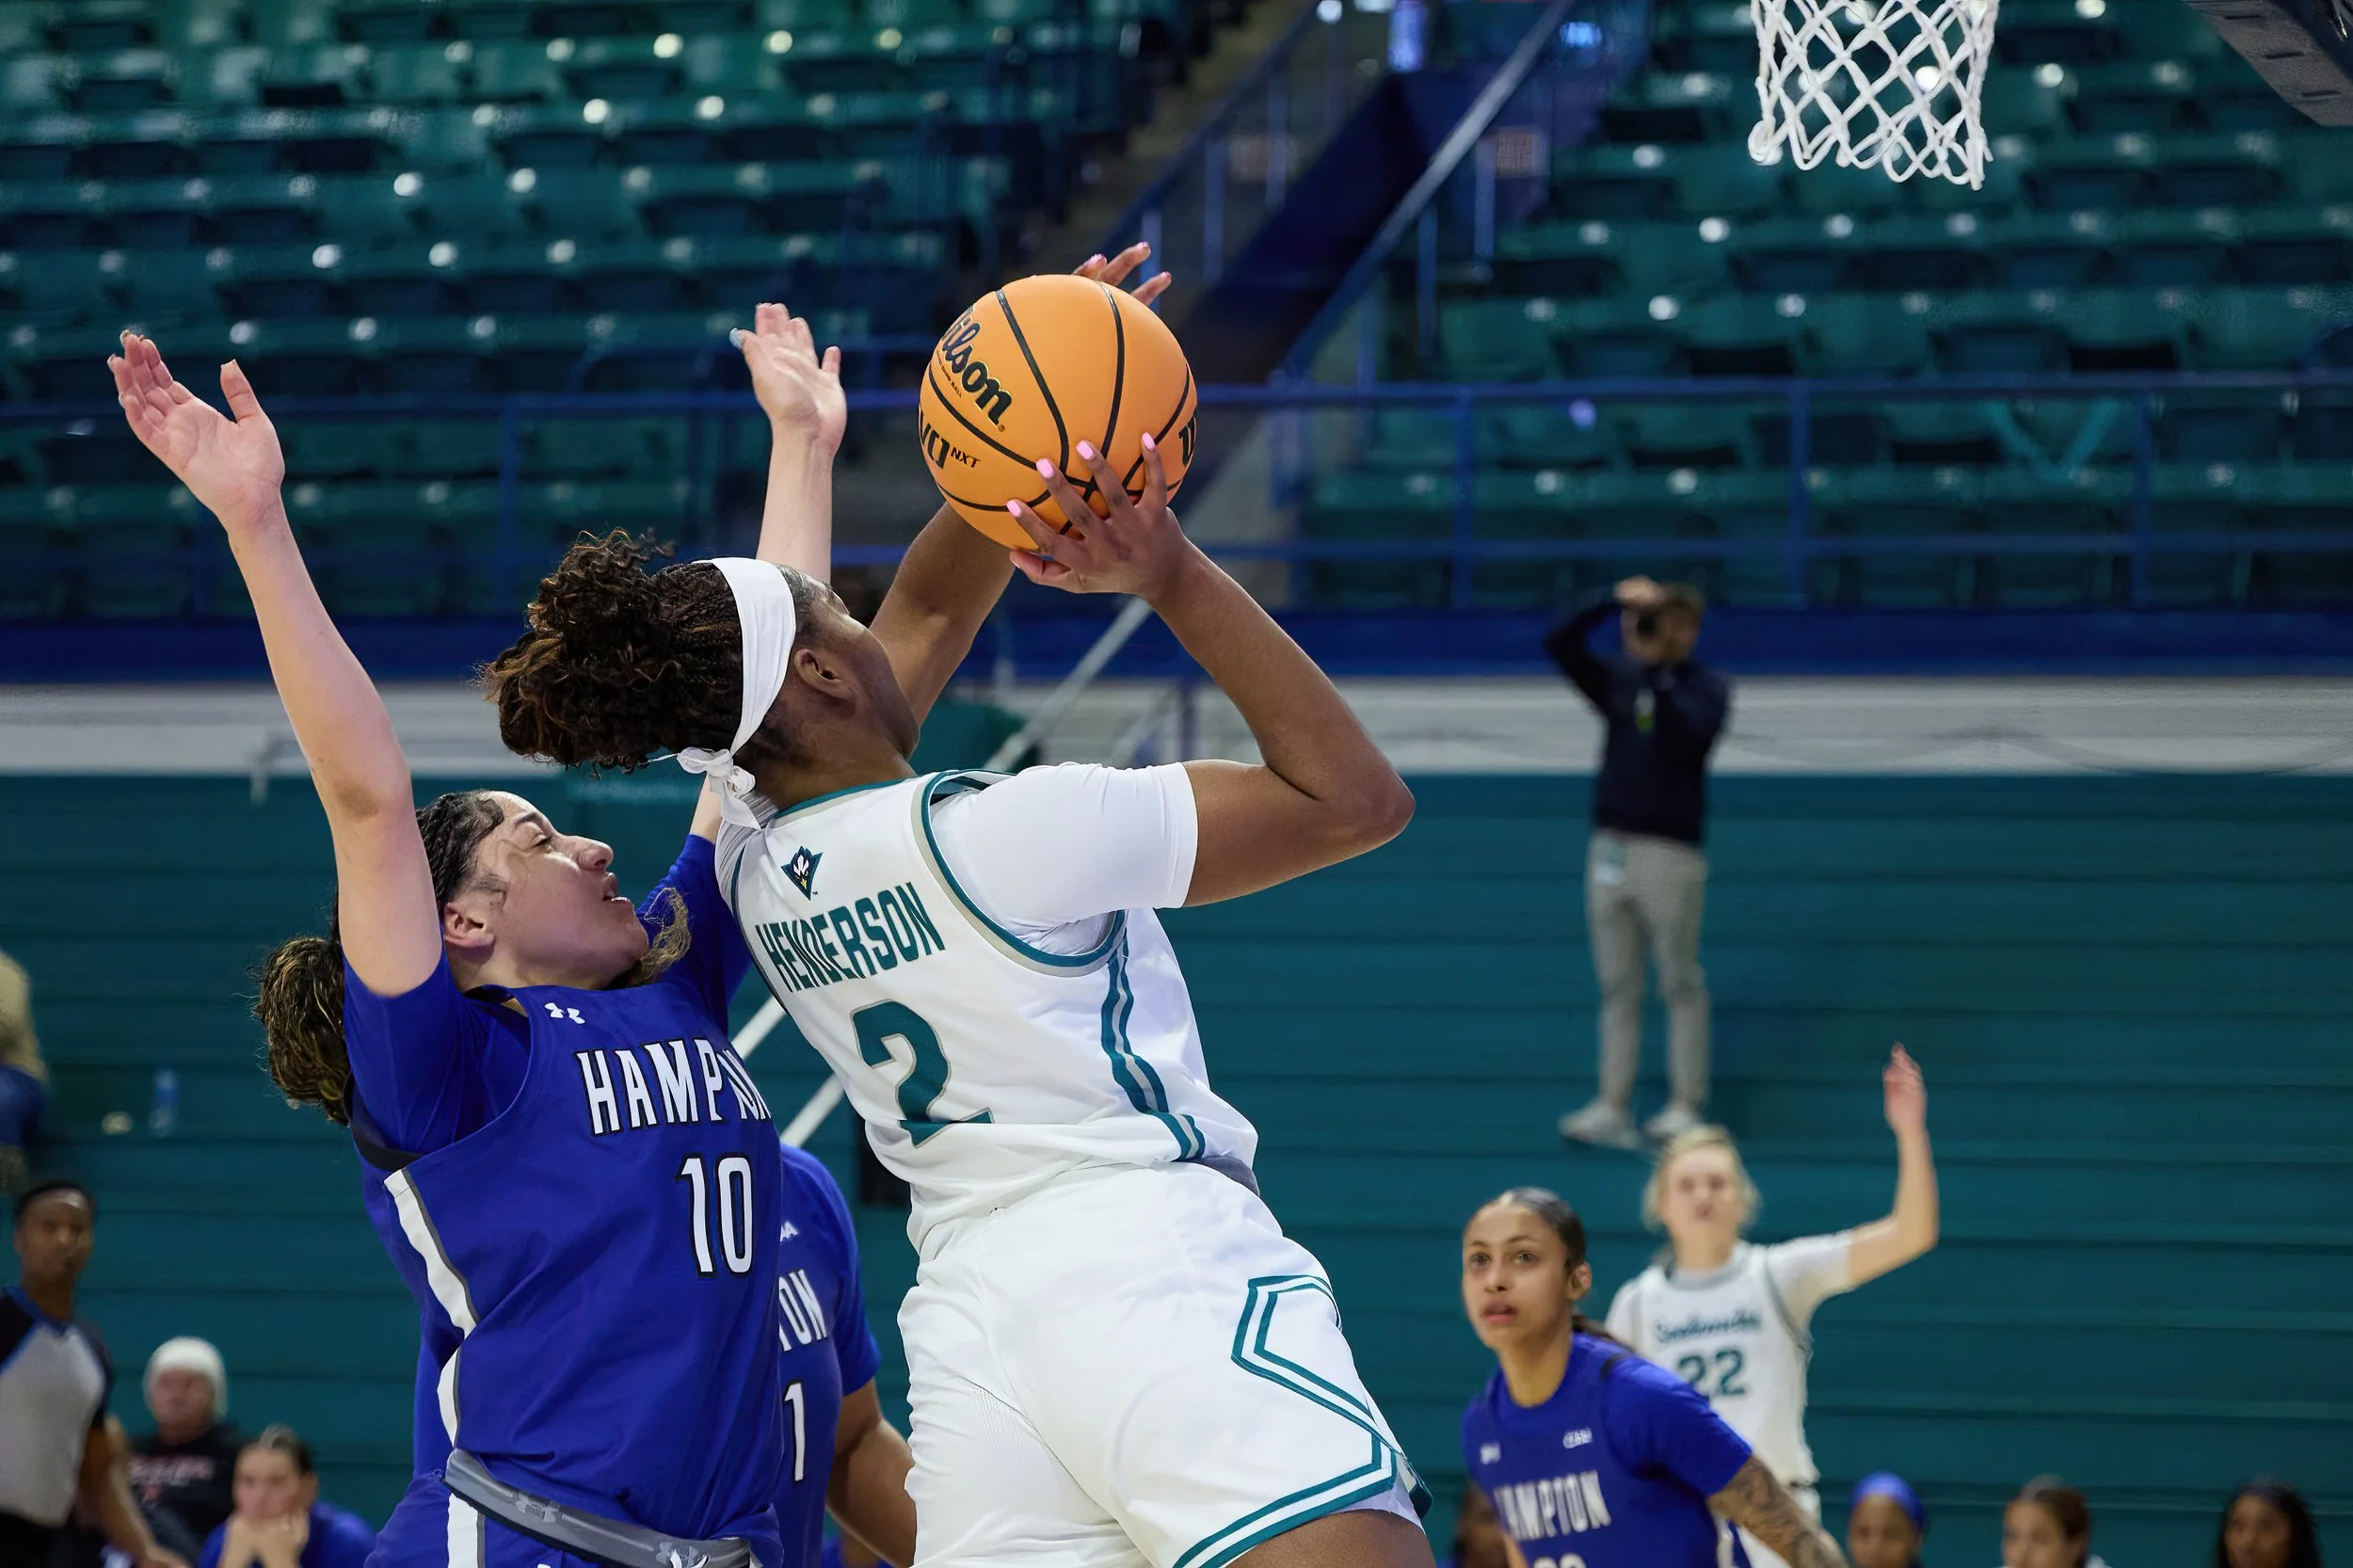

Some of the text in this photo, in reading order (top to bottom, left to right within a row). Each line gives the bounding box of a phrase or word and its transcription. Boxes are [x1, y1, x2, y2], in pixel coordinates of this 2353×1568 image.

[941, 304, 1013, 426] ilson
[951, 446, 981, 469] NXT
[754, 881, 946, 994] HENDERSON
[849, 999, 996, 1149] 2
[677, 1153, 754, 1277] 10
[1677, 1349, 1747, 1396] 22
[1493, 1470, 1612, 1542] AMPTON
